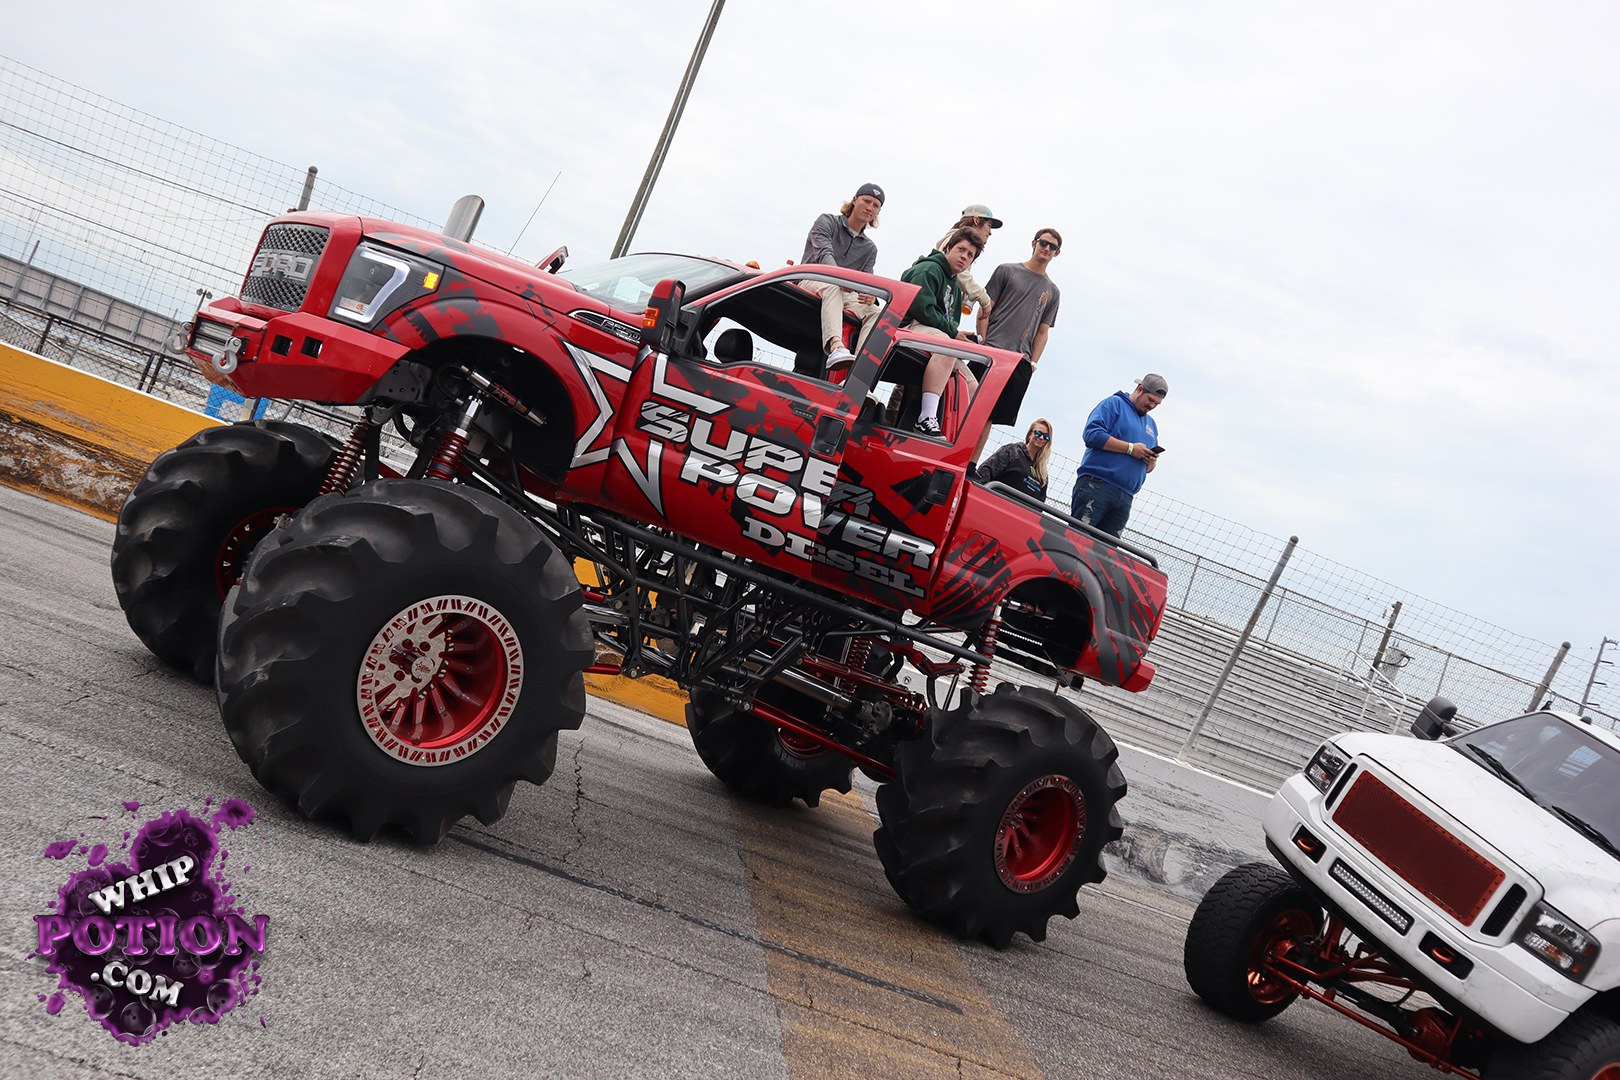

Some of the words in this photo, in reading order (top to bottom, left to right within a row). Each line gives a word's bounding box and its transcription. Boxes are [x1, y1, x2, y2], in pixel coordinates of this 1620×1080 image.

[251, 249, 314, 282] FORD
[639, 401, 875, 517] SUPER
[680, 453, 937, 570] POWER
[742, 516, 926, 598] DIESEL
